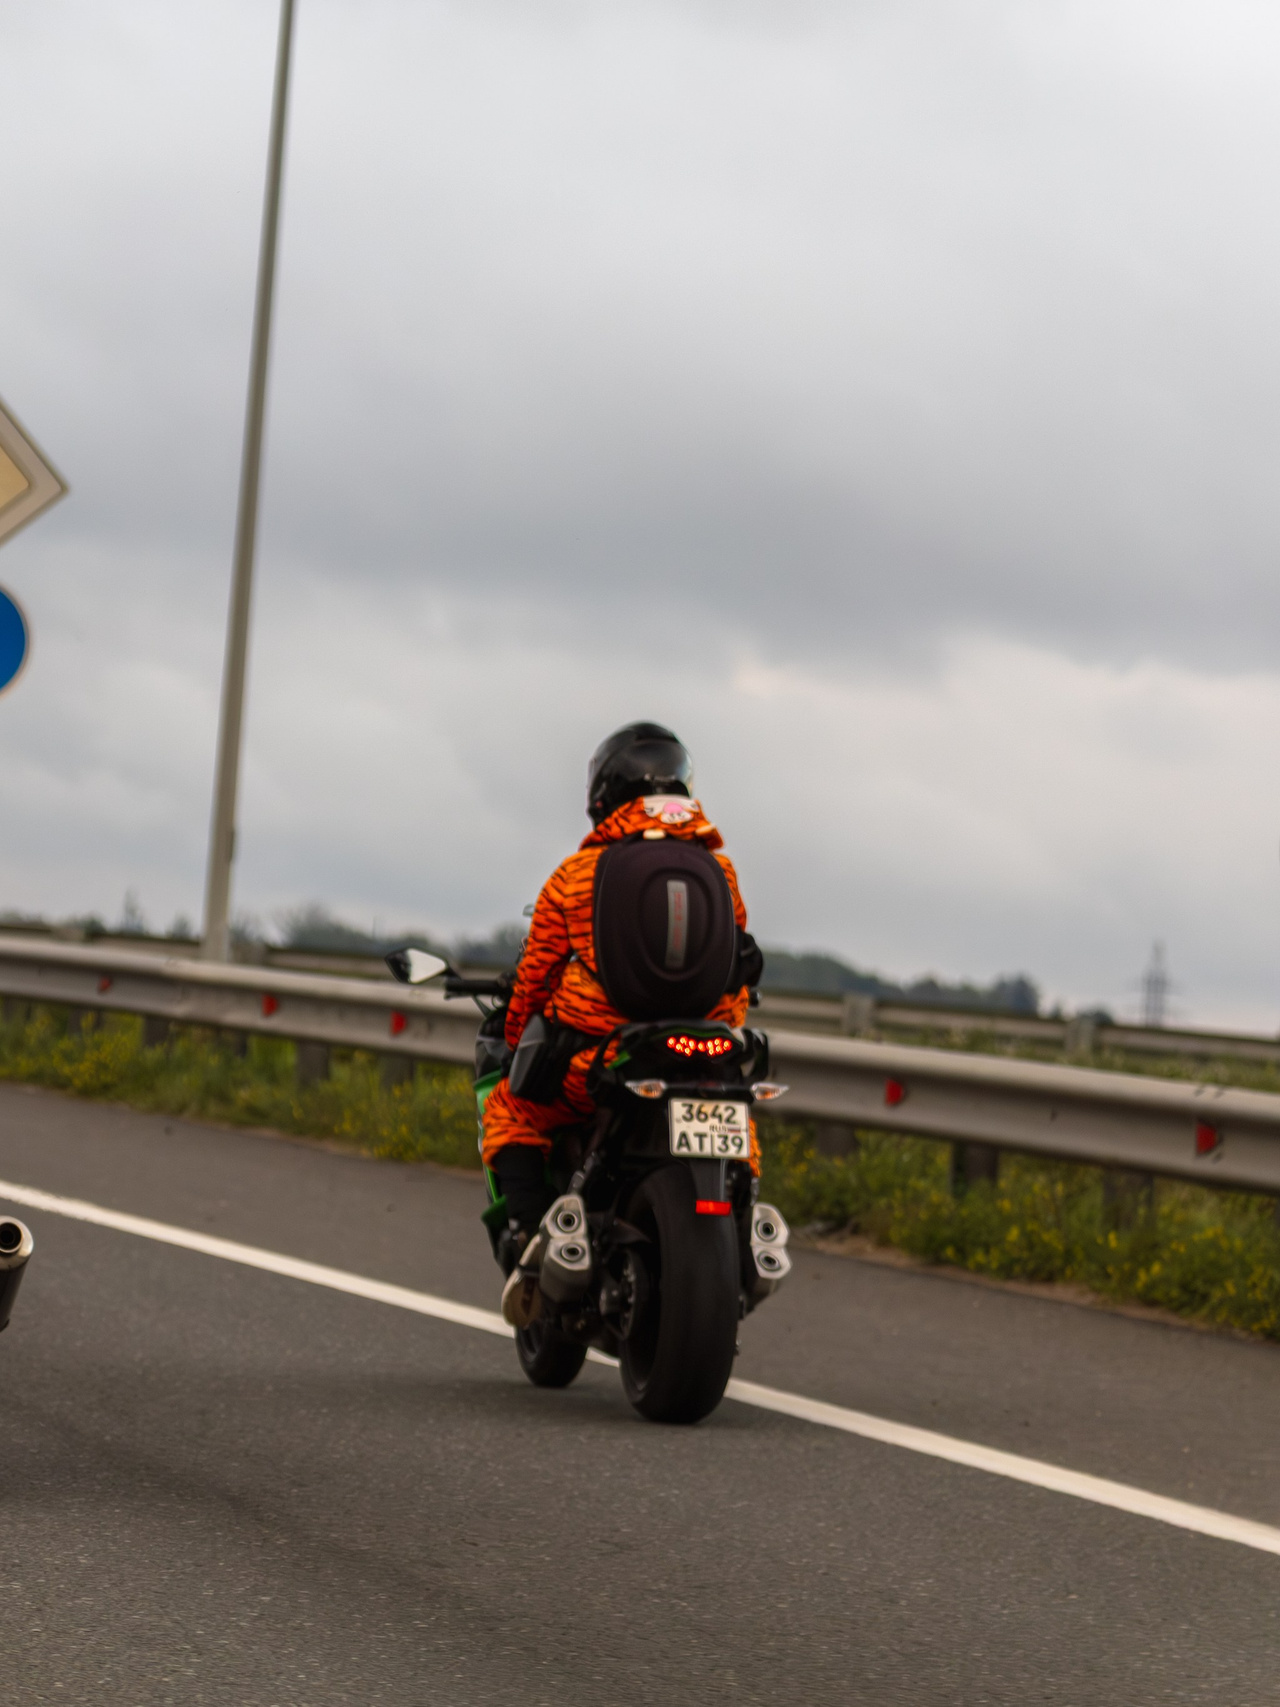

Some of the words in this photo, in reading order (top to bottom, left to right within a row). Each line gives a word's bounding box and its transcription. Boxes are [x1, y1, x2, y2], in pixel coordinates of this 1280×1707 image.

[681, 1103, 738, 1124] 3642
[676, 1131, 708, 1153] AT
[716, 1134, 744, 1154] 39
